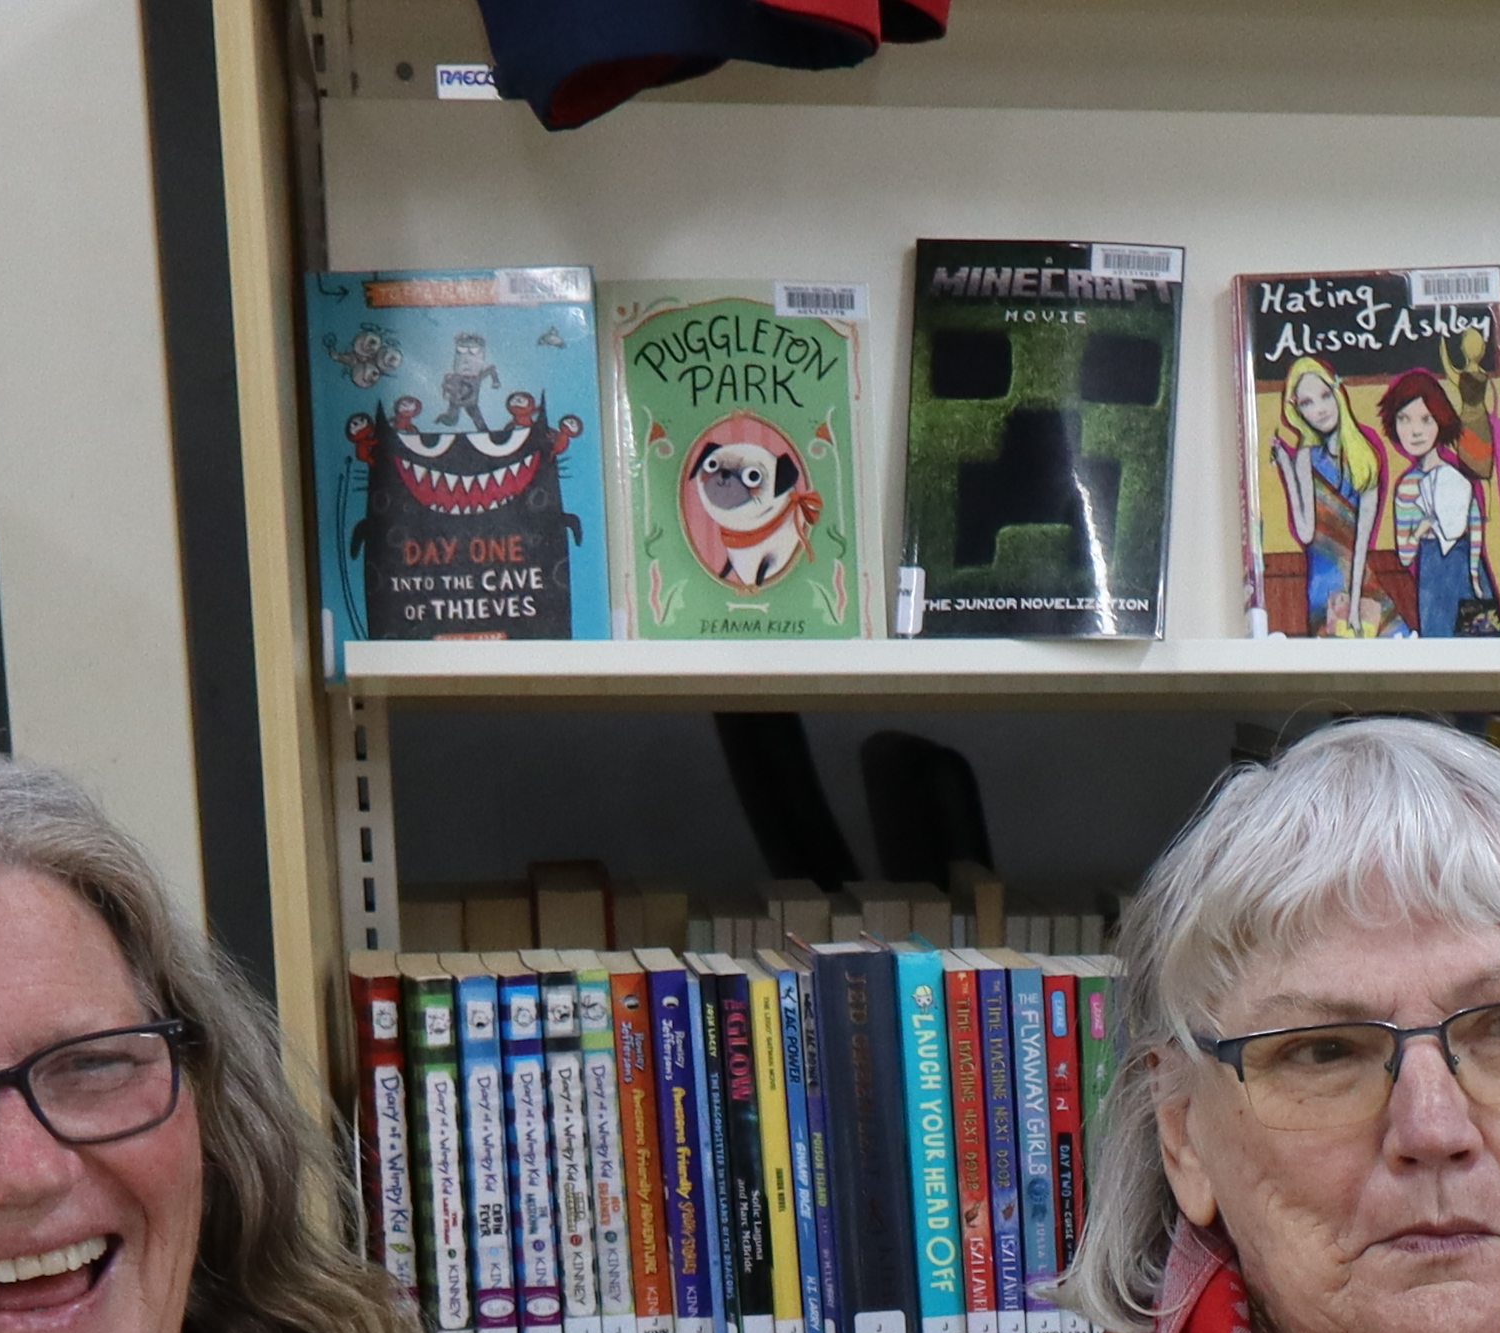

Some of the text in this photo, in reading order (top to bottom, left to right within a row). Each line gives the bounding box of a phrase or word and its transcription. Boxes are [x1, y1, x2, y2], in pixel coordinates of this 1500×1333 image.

[931, 266, 1174, 304] MINECRAFT
[1261, 281, 1390, 322] Hating
[1006, 309, 1087, 324] MOVIE
[1266, 309, 1491, 360] Alison Ashley
[635, 317, 839, 383] PUGGLETON
[677, 364, 803, 408] PARK
[405, 535, 524, 564] DAY ONE
[392, 569, 543, 591] INTO THE CAVE
[405, 597, 536, 621] OF THIEVES
[922, 599, 950, 611] THE
[954, 598, 1015, 611] JUNIOR
[701, 617, 806, 636] DEANNA KIZIS
[1021, 1010, 1045, 1174] FLYAWAY GIRLS
[911, 1014, 954, 1293] LAUGH YOUR HEAD OFF
